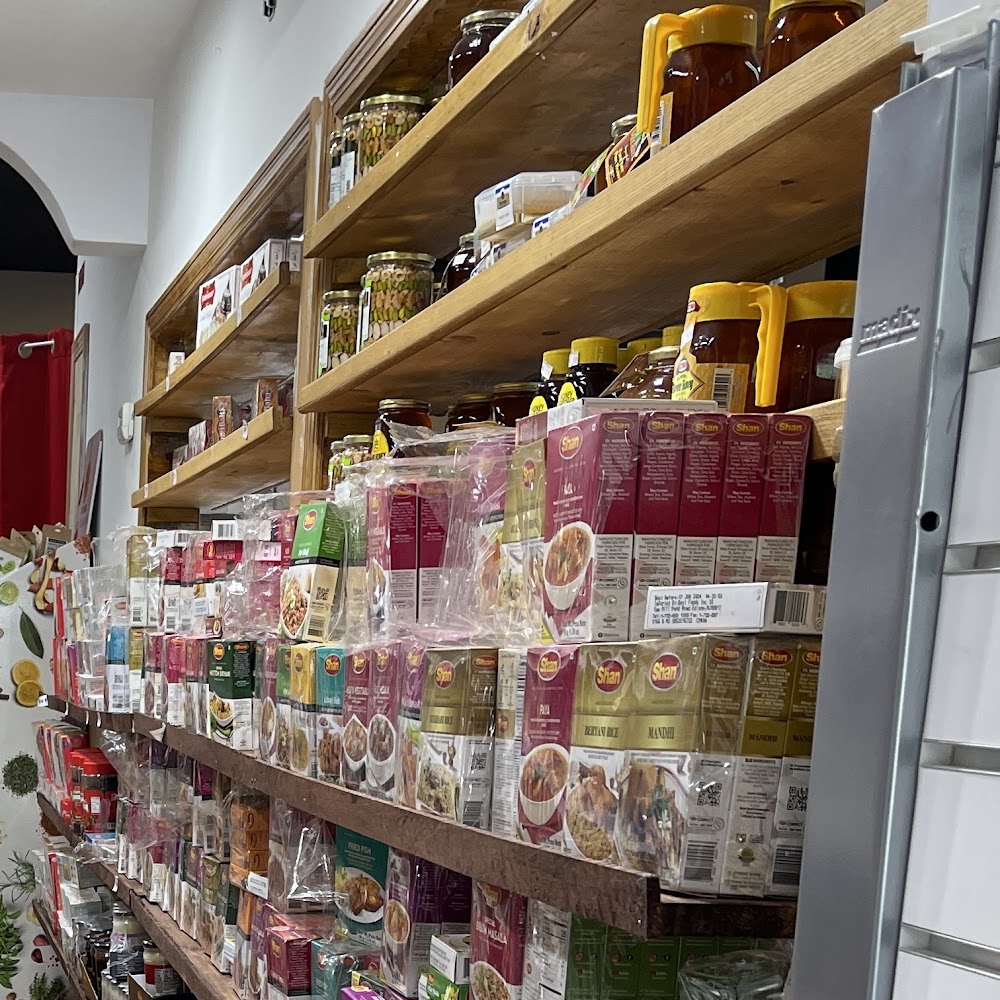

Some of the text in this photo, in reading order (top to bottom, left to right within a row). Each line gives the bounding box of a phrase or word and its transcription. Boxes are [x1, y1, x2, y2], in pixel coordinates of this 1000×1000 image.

[860, 305, 920, 342] madix
[607, 421, 630, 430] Shan
[652, 421, 675, 431] Shan
[695, 422, 718, 432] Shan
[736, 423, 759, 433] Shan
[779, 422, 802, 431] Shan
[561, 435, 579, 452] Shan
[714, 647, 740, 658] Shan
[761, 650, 788, 662] Shan
[806, 652, 820, 661] Sh
[475, 658, 495, 666] Shan
[540, 657, 558, 673] Shan
[597, 666, 621, 685] Shan
[652, 661, 678, 681] Shan
[607, 726, 619, 738] RICE
[648, 726, 675, 739] MANDHI
[749, 734, 778, 742] MANDHI
[487, 927, 507, 945] MASALA
